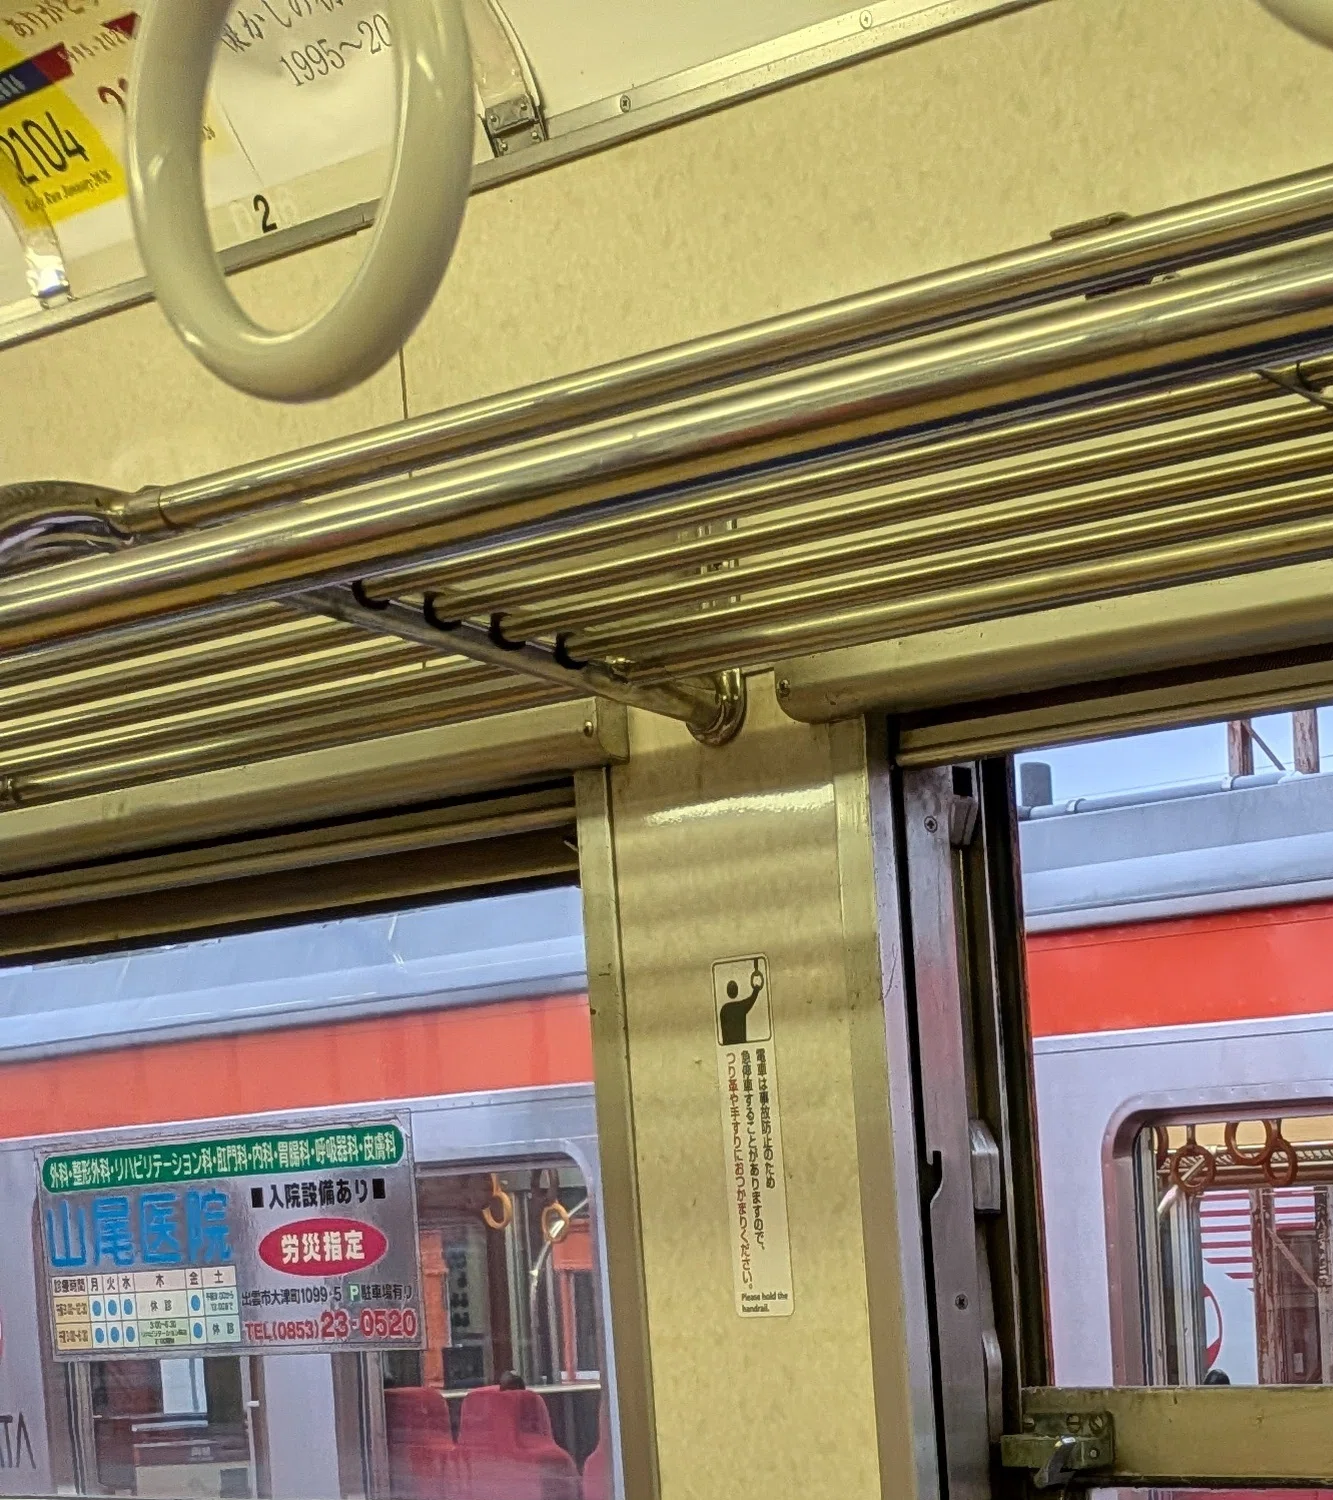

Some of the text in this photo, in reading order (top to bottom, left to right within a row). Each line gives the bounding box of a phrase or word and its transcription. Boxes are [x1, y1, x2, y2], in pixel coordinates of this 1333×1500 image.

[0, 111, 89, 187] 2104
[756, 1048, 775, 1189] 電車は事故防止のため
[726, 1052, 753, 1290] つり革や手すりにおつかまりください。
[47, 1188, 234, 1267] 山尾医院
[281, 1230, 366, 1265] 労災指定
[90, 1277, 99, 1292] 月
[106, 1276, 116, 1291] 火
[122, 1275, 132, 1290] 水
[155, 1273, 165, 1287] 木
[188, 1271, 199, 1286] 金
[214, 1270, 224, 1284] 土
[741, 1291, 788, 1302] Please hold the
